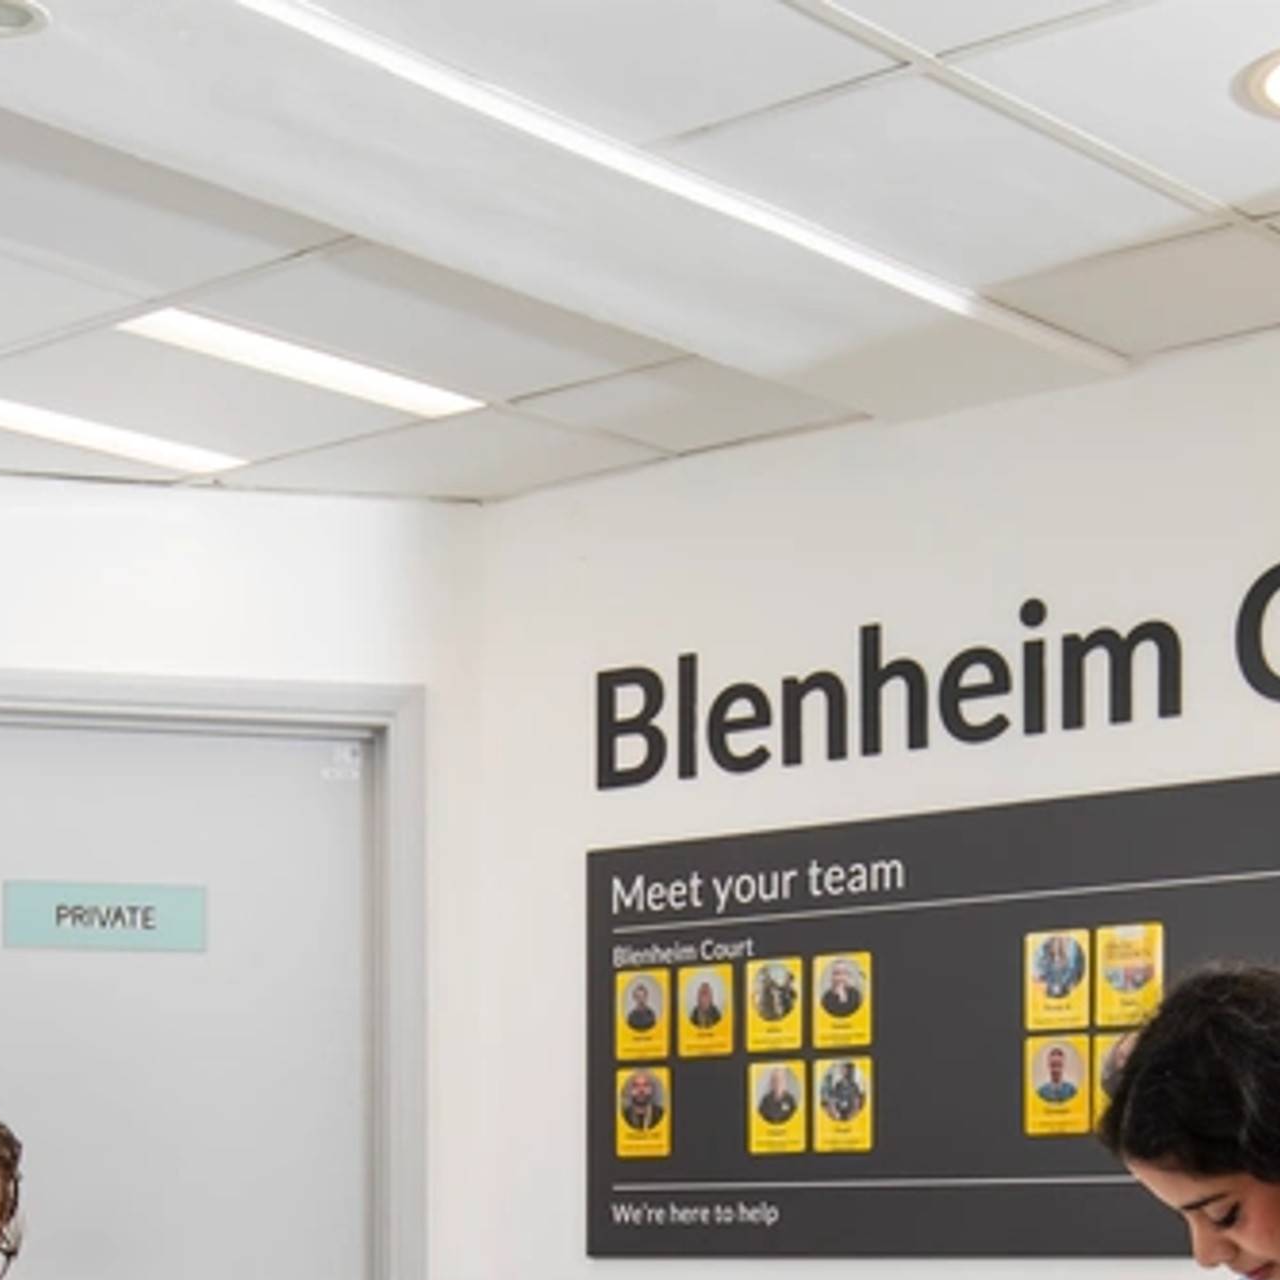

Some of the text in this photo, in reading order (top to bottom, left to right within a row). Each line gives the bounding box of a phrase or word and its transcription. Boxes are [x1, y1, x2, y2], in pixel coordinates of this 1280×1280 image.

[594, 597, 1183, 790] Blenheim
[612, 859, 904, 914] Meet your team
[55, 905, 157, 930] PRIVATE
[612, 938, 754, 968] Blenheim Court
[611, 1201, 780, 1226] We're here to help
